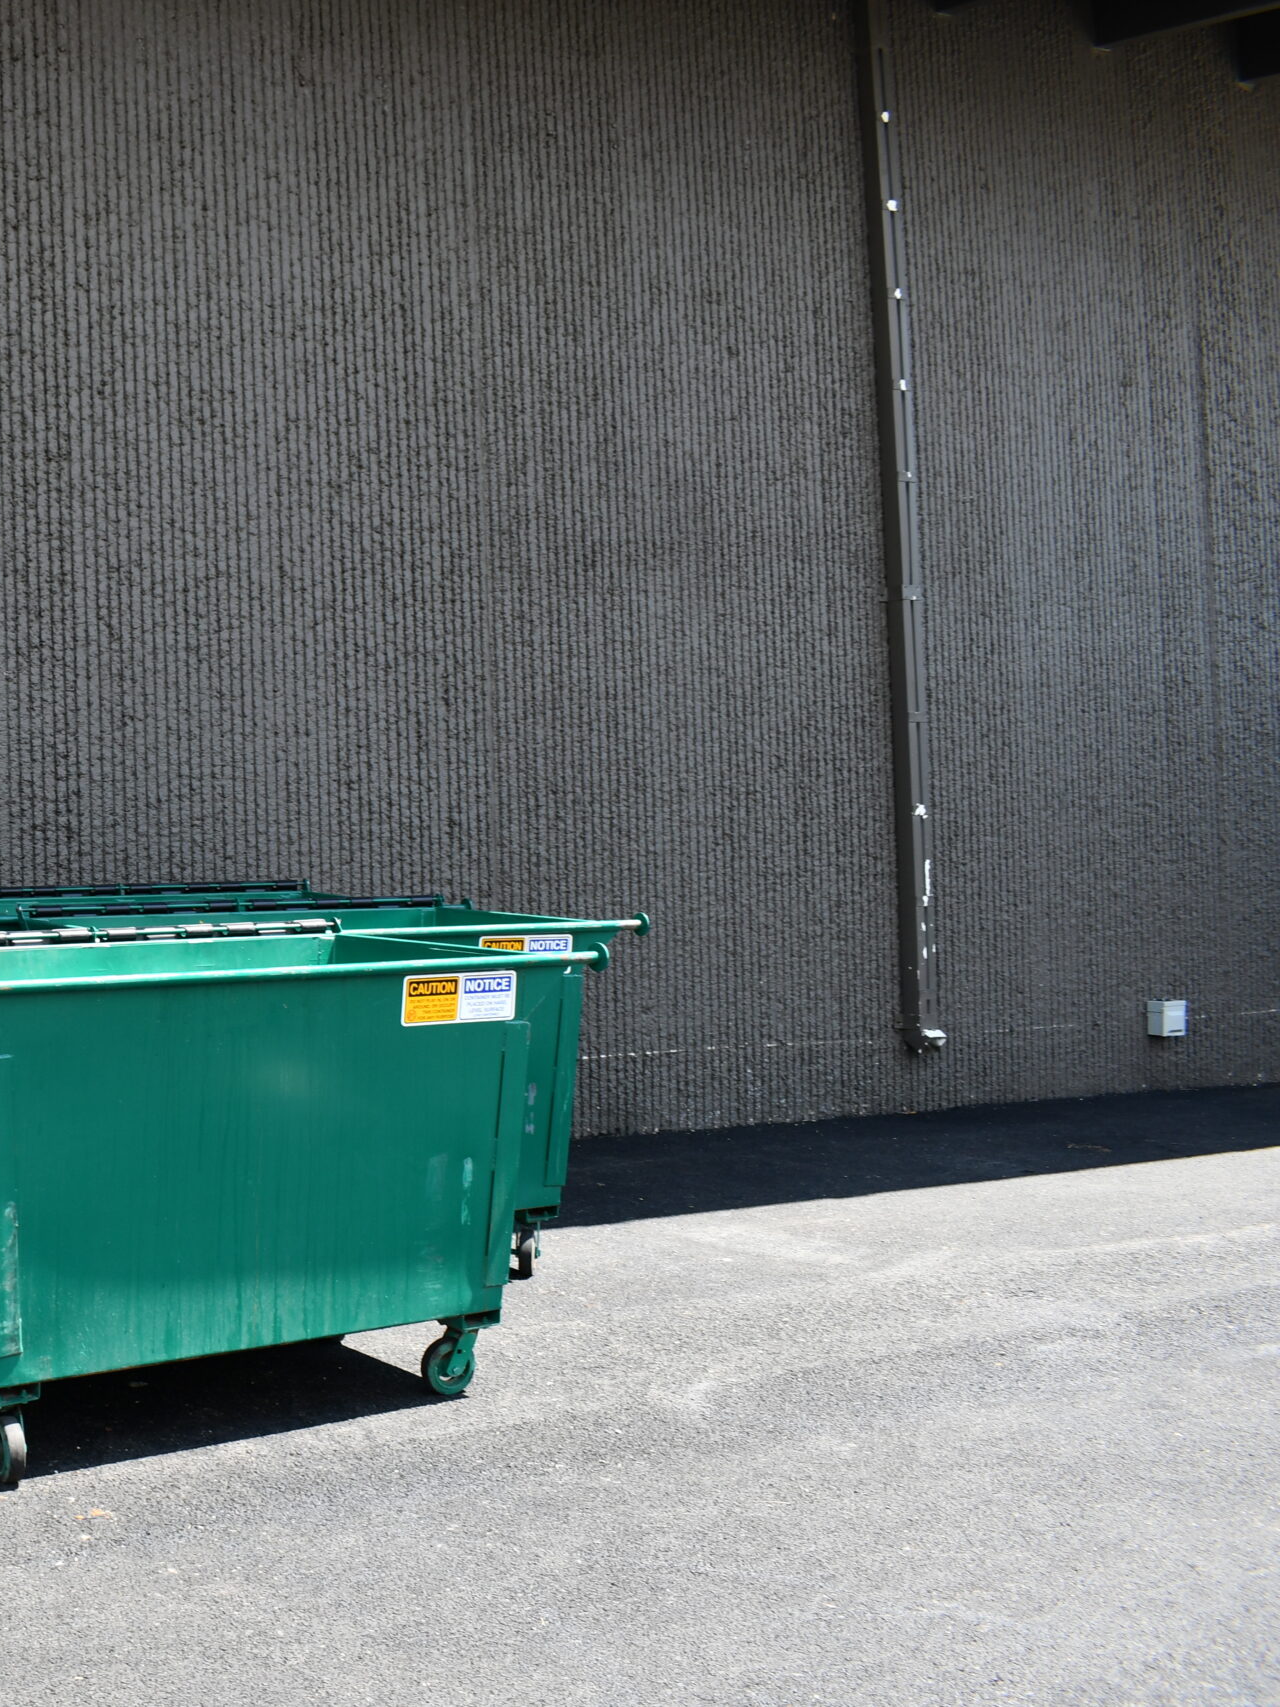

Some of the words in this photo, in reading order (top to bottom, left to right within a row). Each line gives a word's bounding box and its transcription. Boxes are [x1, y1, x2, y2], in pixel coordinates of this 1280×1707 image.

[530, 940, 567, 951] NOTICE
[410, 981, 456, 995] CAUTION
[465, 978, 510, 992] NOTICE
